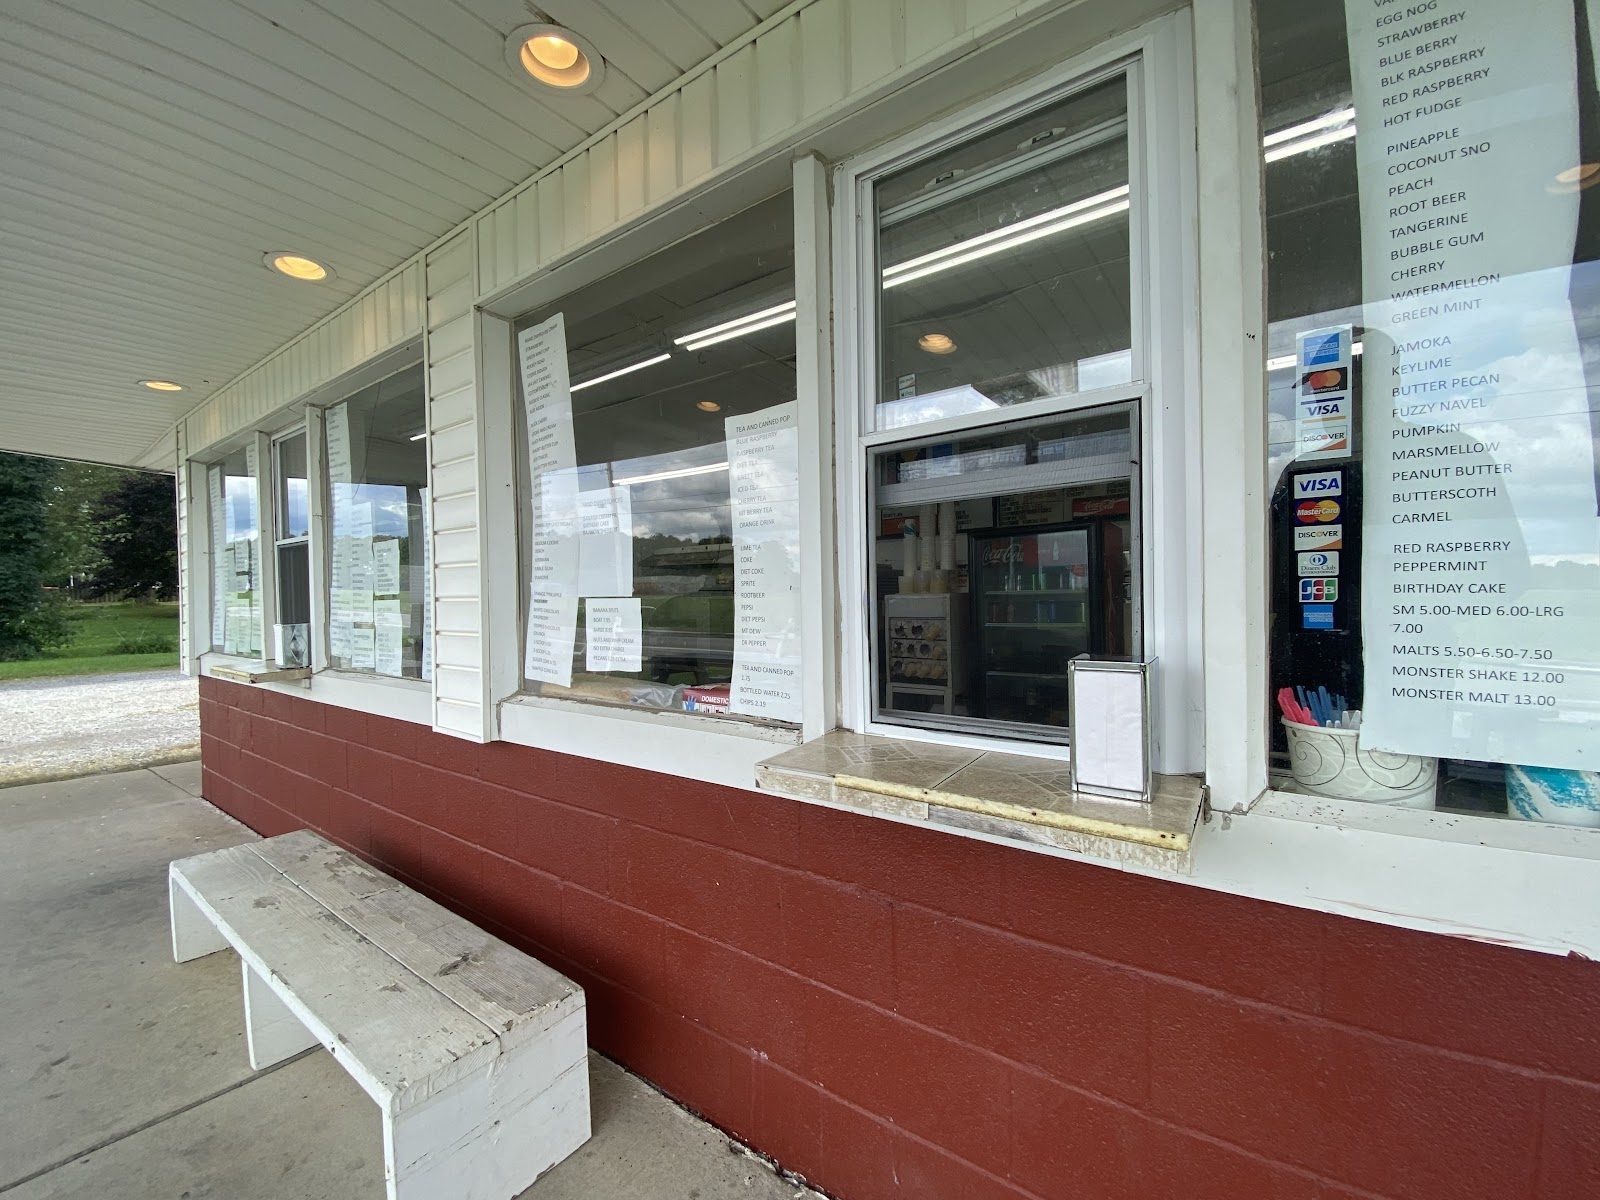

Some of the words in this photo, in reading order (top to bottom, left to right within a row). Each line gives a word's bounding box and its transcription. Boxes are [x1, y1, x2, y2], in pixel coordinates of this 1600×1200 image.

[1376, 11, 1403, 28] EGG
[1407, 0, 1437, 17] NOG
[1378, 11, 1467, 47] STRAWBERRY
[1379, 50, 1412, 67] BLUE
[1416, 35, 1458, 56] BERRY
[1381, 72, 1404, 88] BLK
[1408, 47, 1486, 79] RASPBERRY
[1382, 92, 1408, 107] RED
[1412, 68, 1490, 98] RASPBERRY
[1384, 112, 1411, 128] HOT
[1416, 97, 1462, 118] FUDGE
[1387, 127, 1460, 155] PINEAPPLE
[1388, 149, 1457, 176] COCONUT
[1460, 142, 1491, 158] SNO
[1389, 177, 1433, 197] PEACH
[1390, 199, 1427, 218] ROOT
[1433, 191, 1467, 207] BEER
[1390, 213, 1469, 239] TANGERINE
[1391, 239, 1444, 261] BUBBLE
[1448, 232, 1484, 247] GUM
[1391, 261, 1445, 282] CHERRY
[1391, 273, 1500, 302] WATERMELLON
[1392, 306, 1439, 324] GREEN
[1444, 299, 1482, 314] MINT
[1391, 336, 1452, 356] JAMOKA
[1392, 357, 1452, 376] KEYLIME
[1392, 380, 1447, 397] BUTTER
[1452, 374, 1500, 389] PECAN
[1306, 404, 1340, 416] VISA
[1392, 403, 1435, 418] FUZZY
[1440, 398, 1487, 412] NAVEL
[736, 425, 746, 433] TEA
[747, 423, 758, 431] AND
[759, 418, 780, 430] CANNED
[781, 415, 791, 424] POP
[1392, 423, 1461, 439] PUMPKIN
[736, 437, 749, 445] BLUE
[750, 431, 778, 443] RASPBERRY
[1303, 433, 1345, 443] DISCOVER
[736, 447, 764, 457] RASPBERRY
[765, 444, 775, 452] TEA
[1392, 441, 1500, 461] MARSMELLOW
[1392, 467, 1451, 482] PEANUT
[1455, 463, 1513, 477] BUTTER
[1299, 478, 1340, 492] VISA
[756, 495, 767, 503] TEA
[1392, 487, 1497, 503] BUTTERSCOTH
[747, 508, 763, 516] BERRY
[763, 506, 773, 514] TEA
[1297, 507, 1339, 517] MasterCard
[1392, 511, 1452, 524] CARMEL
[740, 520, 759, 529] ORANGE
[759, 518, 775, 527] DRINK
[1298, 530, 1338, 538] DISCOVER
[1394, 544, 1421, 554] RED
[1426, 541, 1511, 553] RASPBERRY
[1393, 561, 1488, 572] PEPPERMINT
[1302, 586, 1335, 594] JCB
[1393, 583, 1464, 594] BIRTHDAY
[1468, 583, 1507, 594] CAKE
[1392, 605, 1415, 615] SM
[1419, 605, 1491, 616] 5.00-MED
[1496, 606, 1564, 617] 6.00-LRG
[1393, 623, 1423, 634] 7.00
[1392, 645, 1440, 656] MALTS
[1444, 646, 1553, 660] 5.50-6.50-7.50
[742, 664, 750, 672] TEA
[750, 665, 762, 673] AND
[762, 667, 783, 676] CANNED
[783, 668, 795, 677] POP
[1392, 666, 1464, 679] MONSTER
[1469, 669, 1517, 682] SHAKE
[1523, 672, 1565, 684] 12.00
[701, 695, 729, 705] DOMESTIC
[741, 686, 762, 695] BOTTLED
[763, 689, 780, 698] WATER
[1392, 687, 1464, 701] MONSTER
[1469, 692, 1510, 704] MALT
[1514, 695, 1556, 707] 13.00
